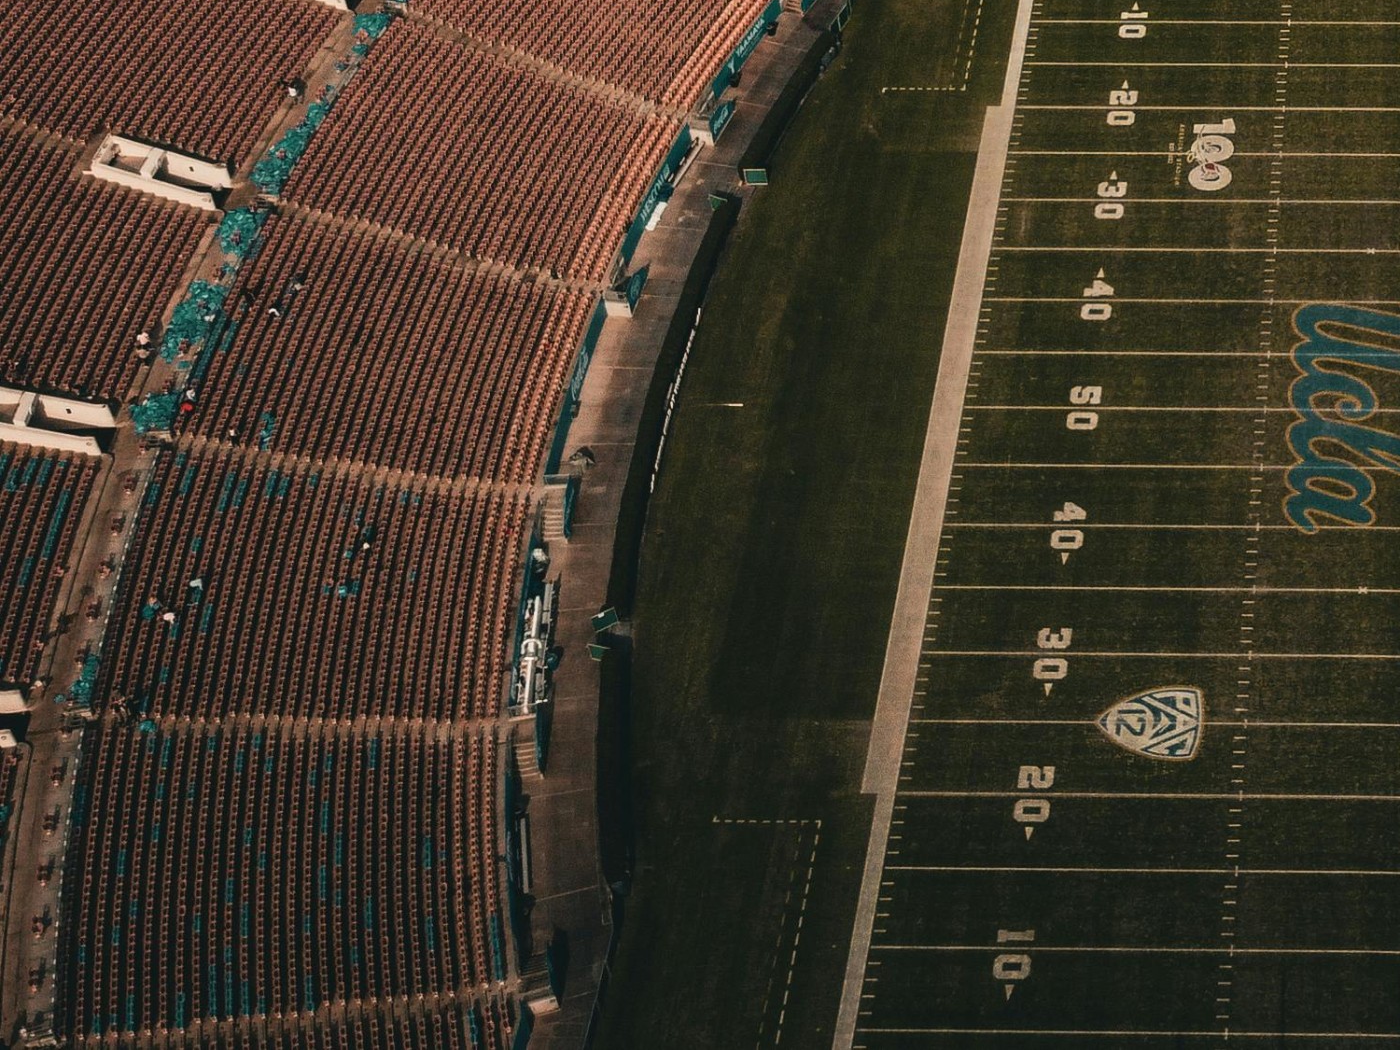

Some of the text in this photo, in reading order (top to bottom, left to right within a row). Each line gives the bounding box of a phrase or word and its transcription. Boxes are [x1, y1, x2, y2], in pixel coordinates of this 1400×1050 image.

[1119, 12, 1148, 38] 10
[1107, 90, 1138, 126] 20
[1188, 118, 1236, 191] 100
[1094, 181, 1127, 219] 30
[1080, 279, 1114, 321] 40
[1066, 385, 1102, 430] 50
[1050, 502, 1087, 549] 40
[1033, 627, 1072, 680] 30
[1012, 765, 1055, 822] 20
[993, 929, 1035, 980] 10
